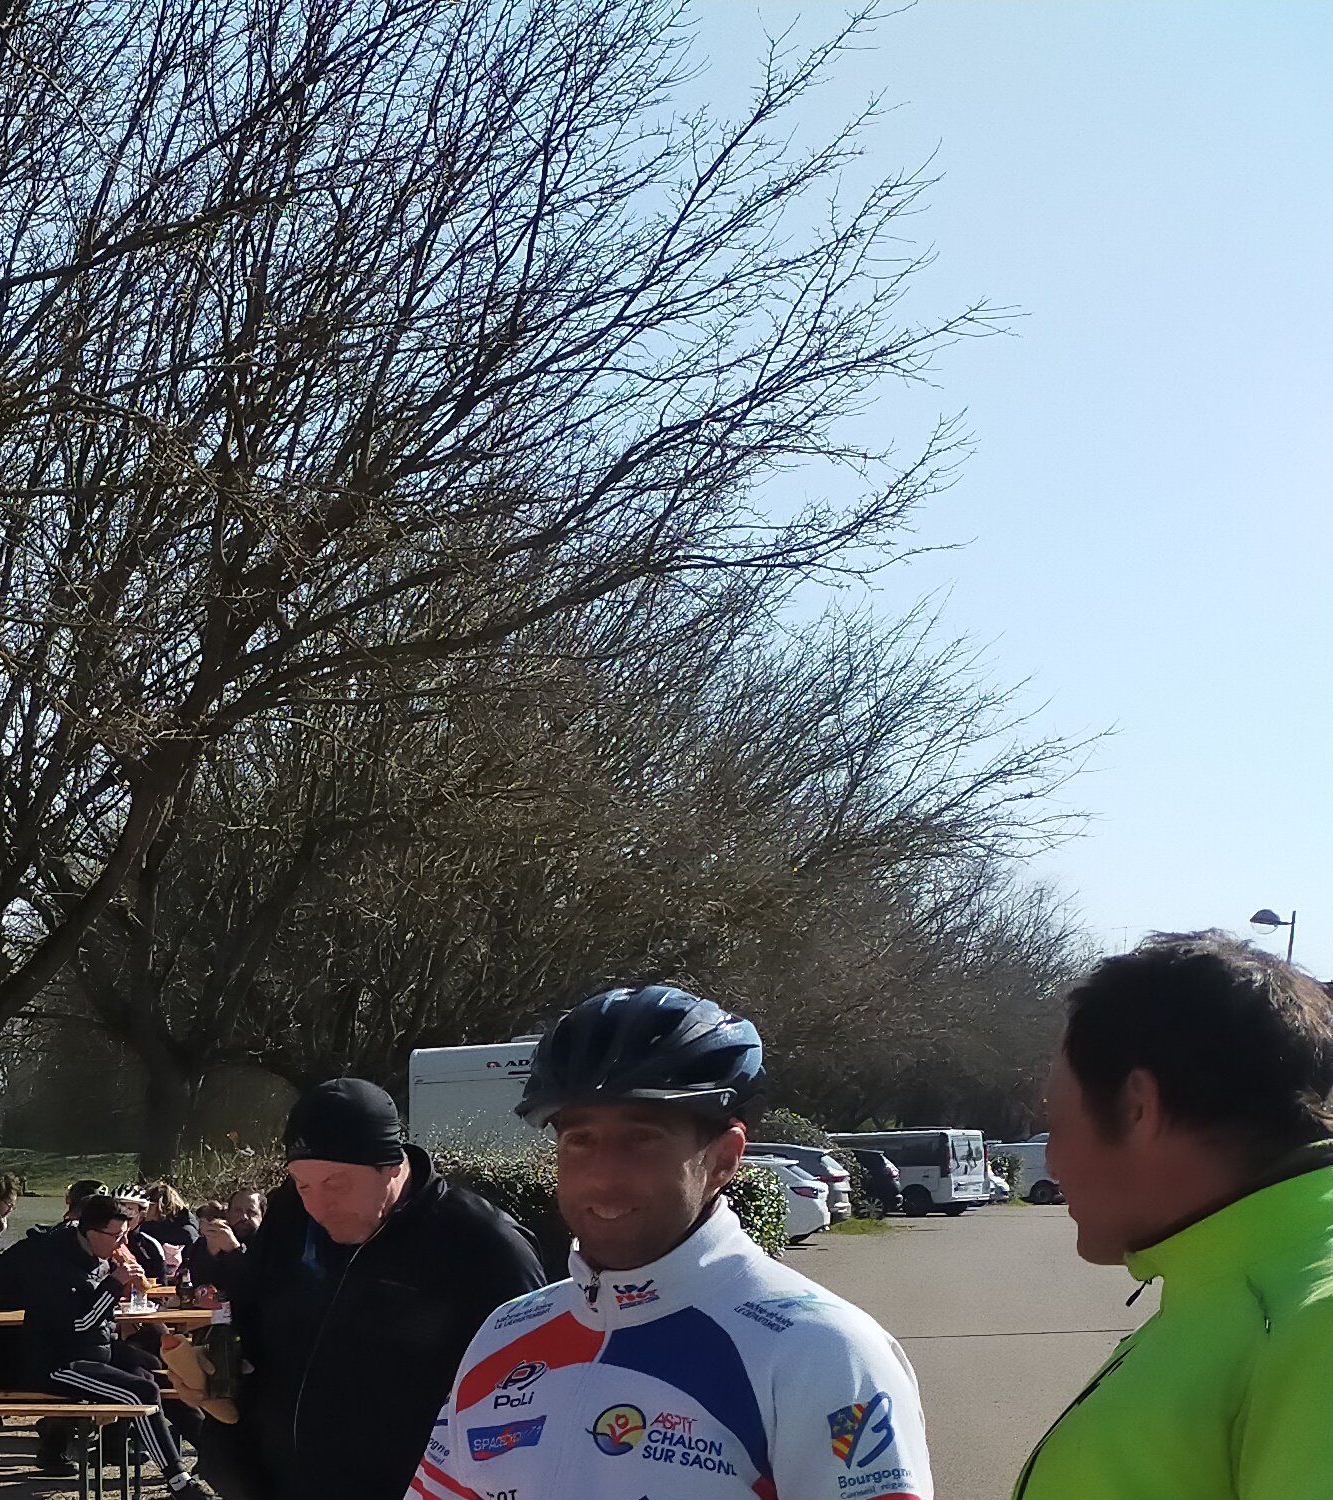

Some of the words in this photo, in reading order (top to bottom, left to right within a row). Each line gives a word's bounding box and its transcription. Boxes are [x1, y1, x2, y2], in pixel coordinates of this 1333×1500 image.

[647, 1429, 723, 1457] CHALON
[642, 1445, 676, 1464] SUR
[837, 1468, 914, 1489] Bourgogn
